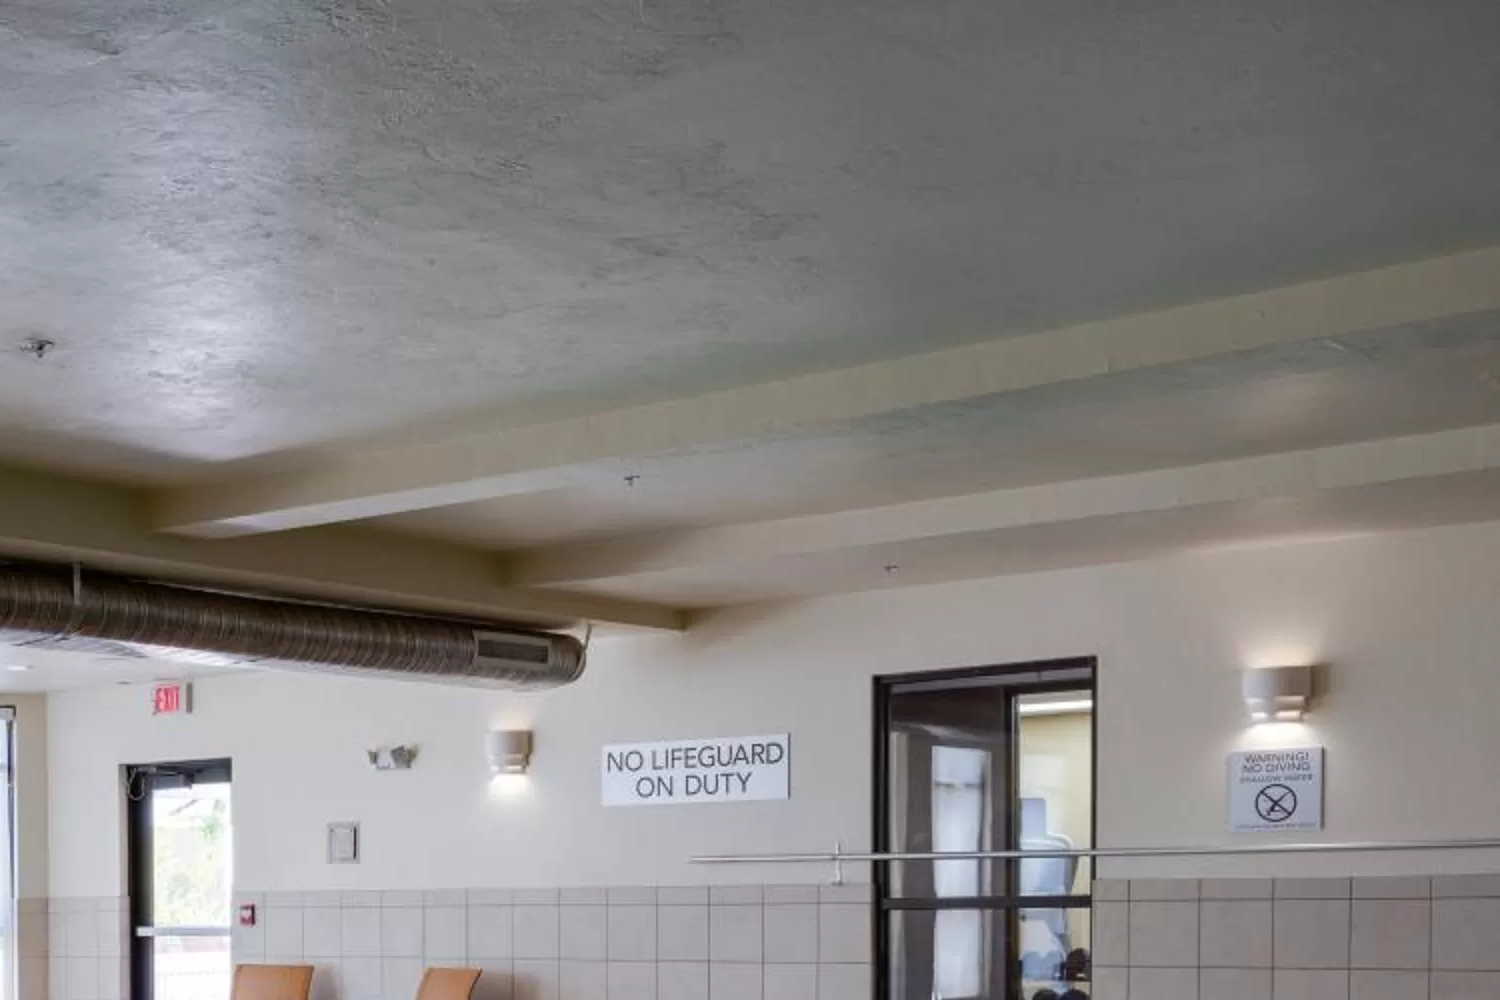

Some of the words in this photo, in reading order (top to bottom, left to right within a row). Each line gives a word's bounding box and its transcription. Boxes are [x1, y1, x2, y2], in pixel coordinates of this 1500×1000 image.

[155, 687, 180, 712] EXIT
[607, 751, 644, 773] NO
[652, 743, 784, 771] LIFEGUARD
[1243, 763, 1262, 773] NO
[635, 776, 674, 798] ON
[685, 772, 752, 797] DUTY
